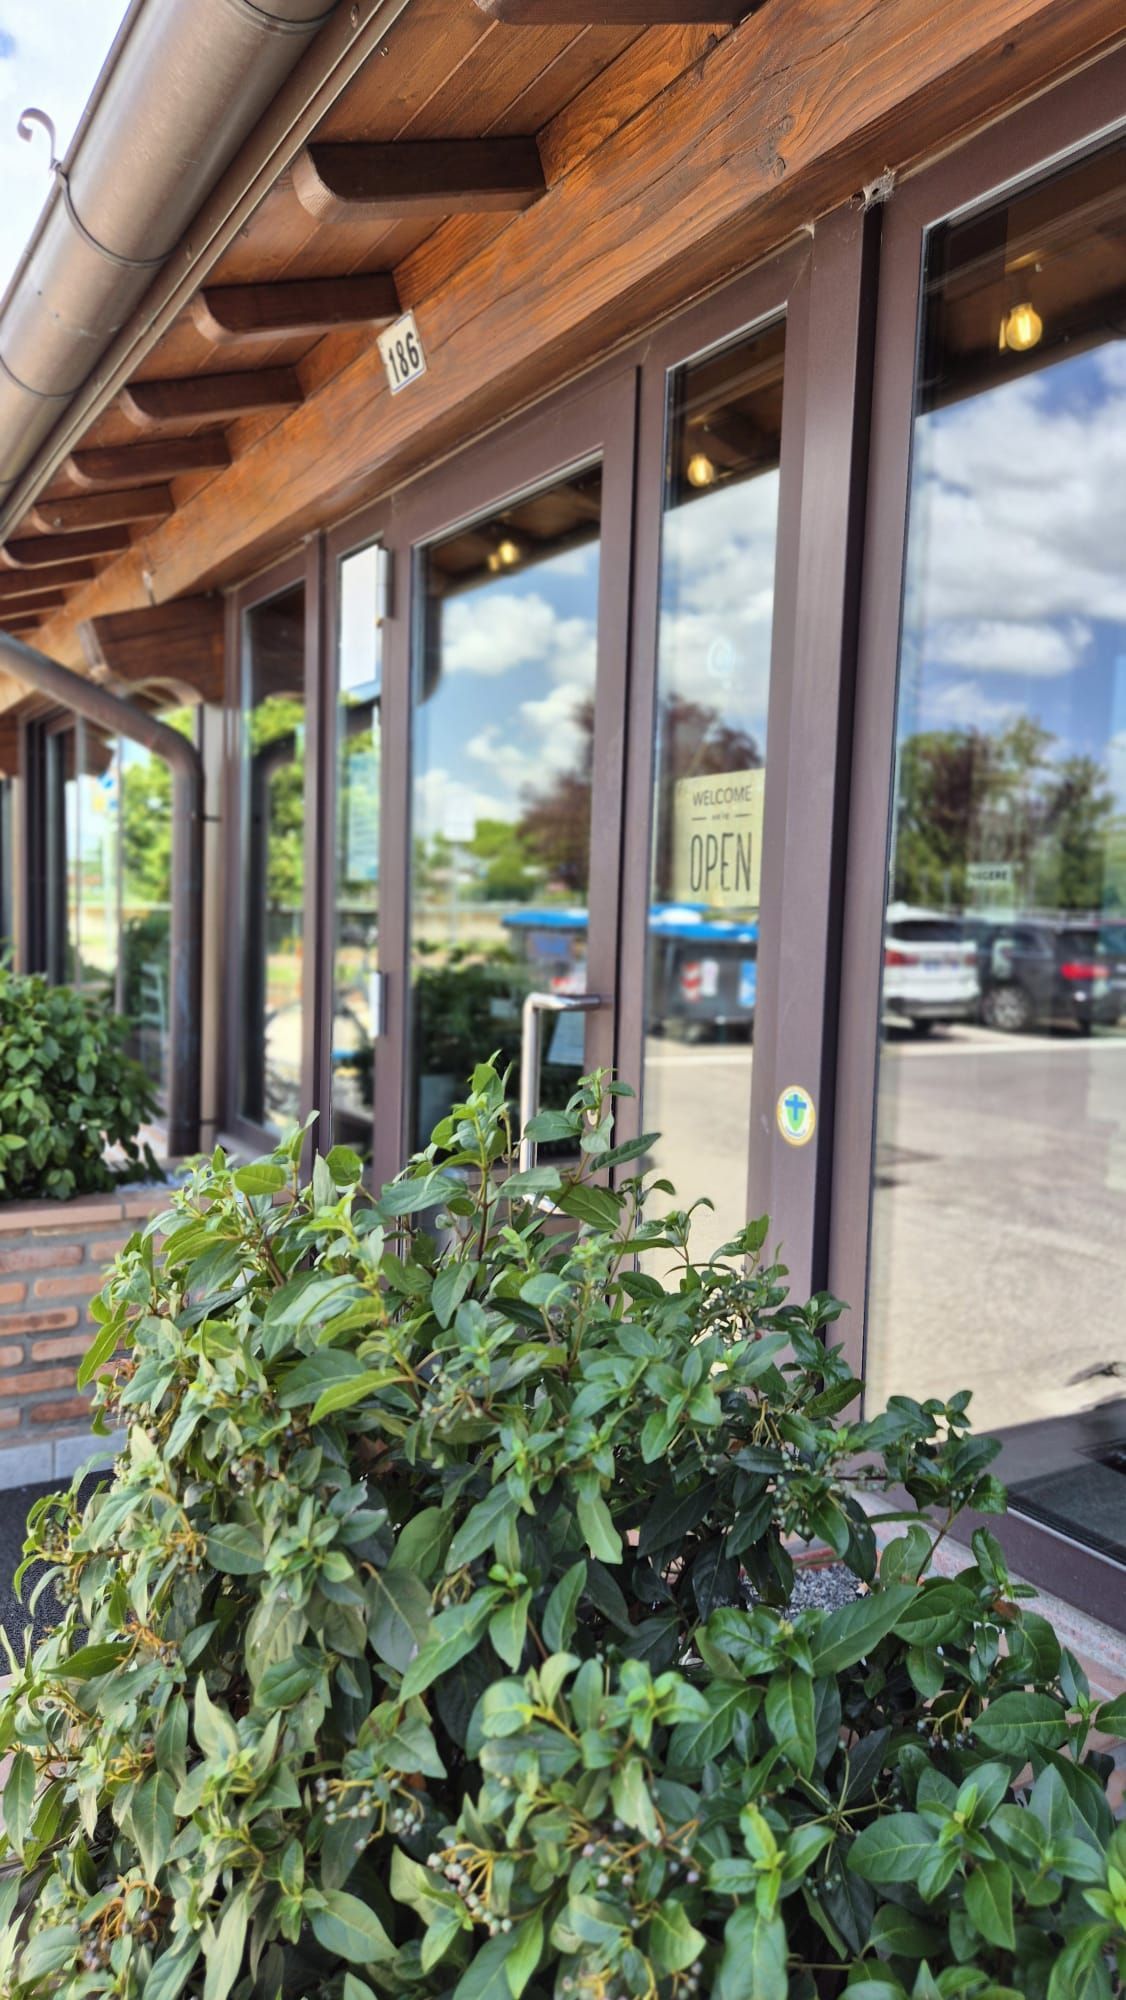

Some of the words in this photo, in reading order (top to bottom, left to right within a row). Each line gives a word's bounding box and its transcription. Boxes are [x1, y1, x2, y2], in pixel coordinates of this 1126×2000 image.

[389, 331, 420, 383] 186
[692, 785, 752, 807] WELCOME
[690, 832, 752, 892] OPEN
